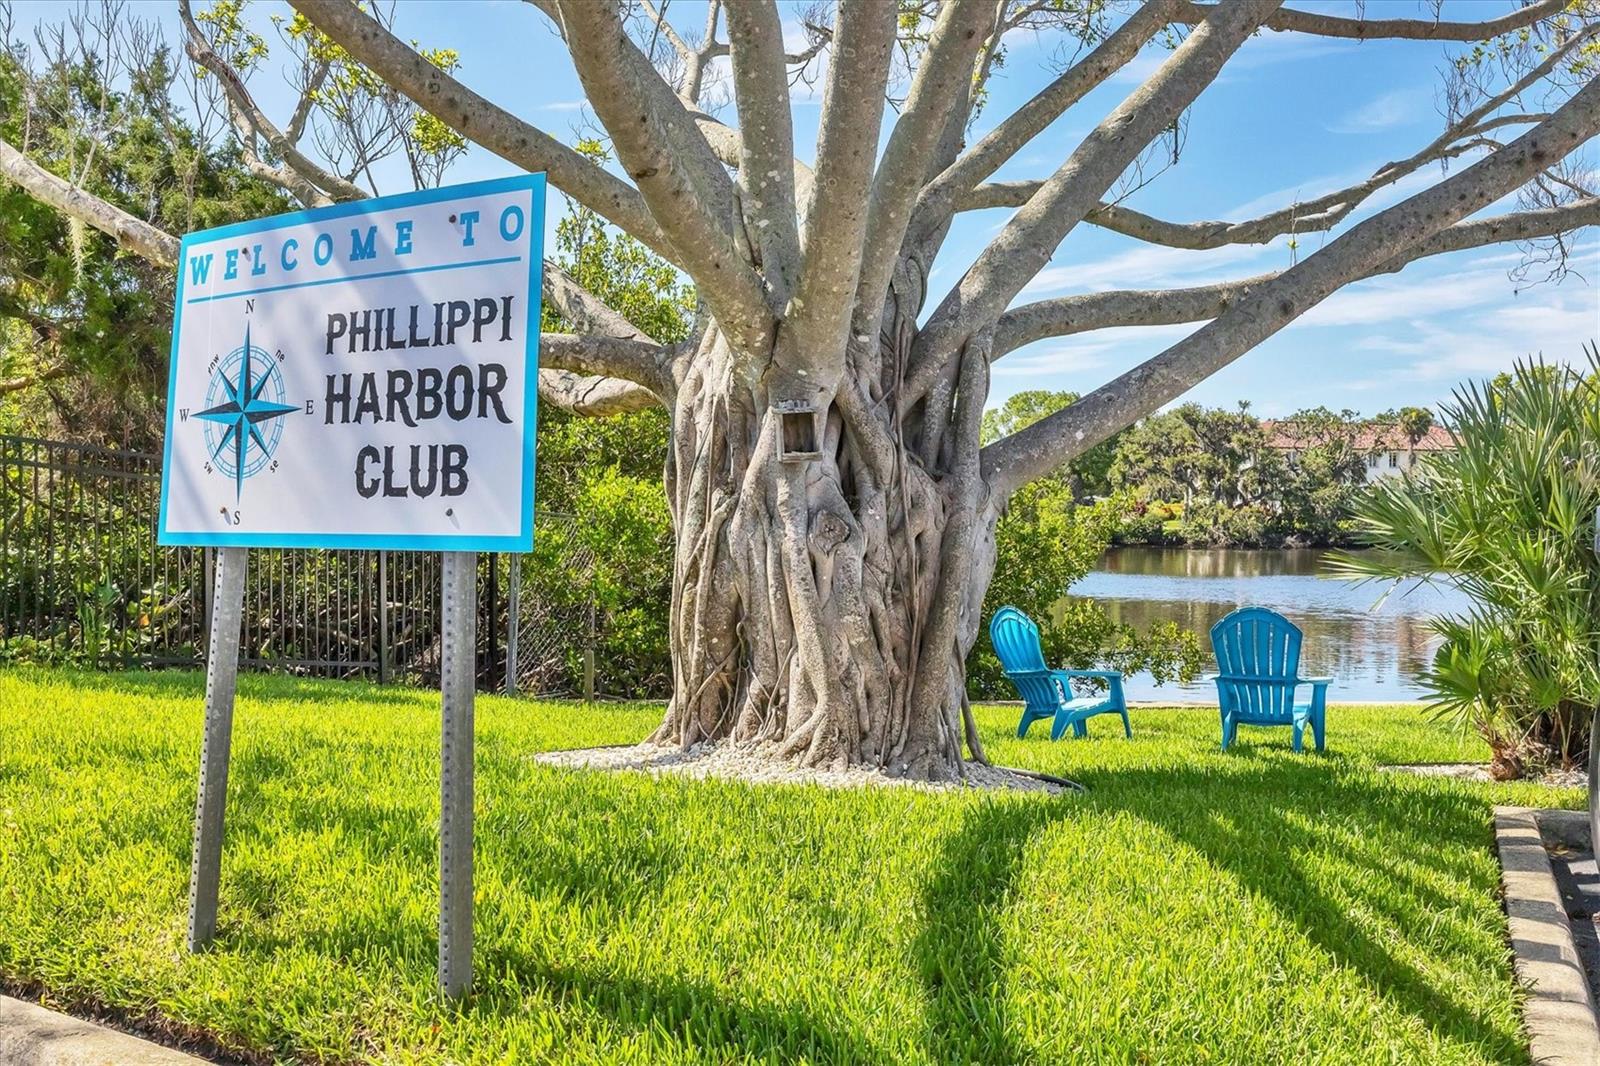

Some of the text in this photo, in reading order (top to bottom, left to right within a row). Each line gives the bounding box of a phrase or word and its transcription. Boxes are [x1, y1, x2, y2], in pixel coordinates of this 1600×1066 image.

[190, 205, 524, 286] WELCOME TO
[245, 299, 255, 314] N
[326, 296, 514, 355] PHILLIPPI
[275, 349, 285, 362] ne
[324, 363, 513, 427] HARBOR
[305, 400, 314, 415] E
[179, 408, 190, 423] W
[204, 461, 214, 474] sw
[269, 460, 279, 473] se
[355, 444, 469, 499] CLUB
[233, 510, 241, 526] S
